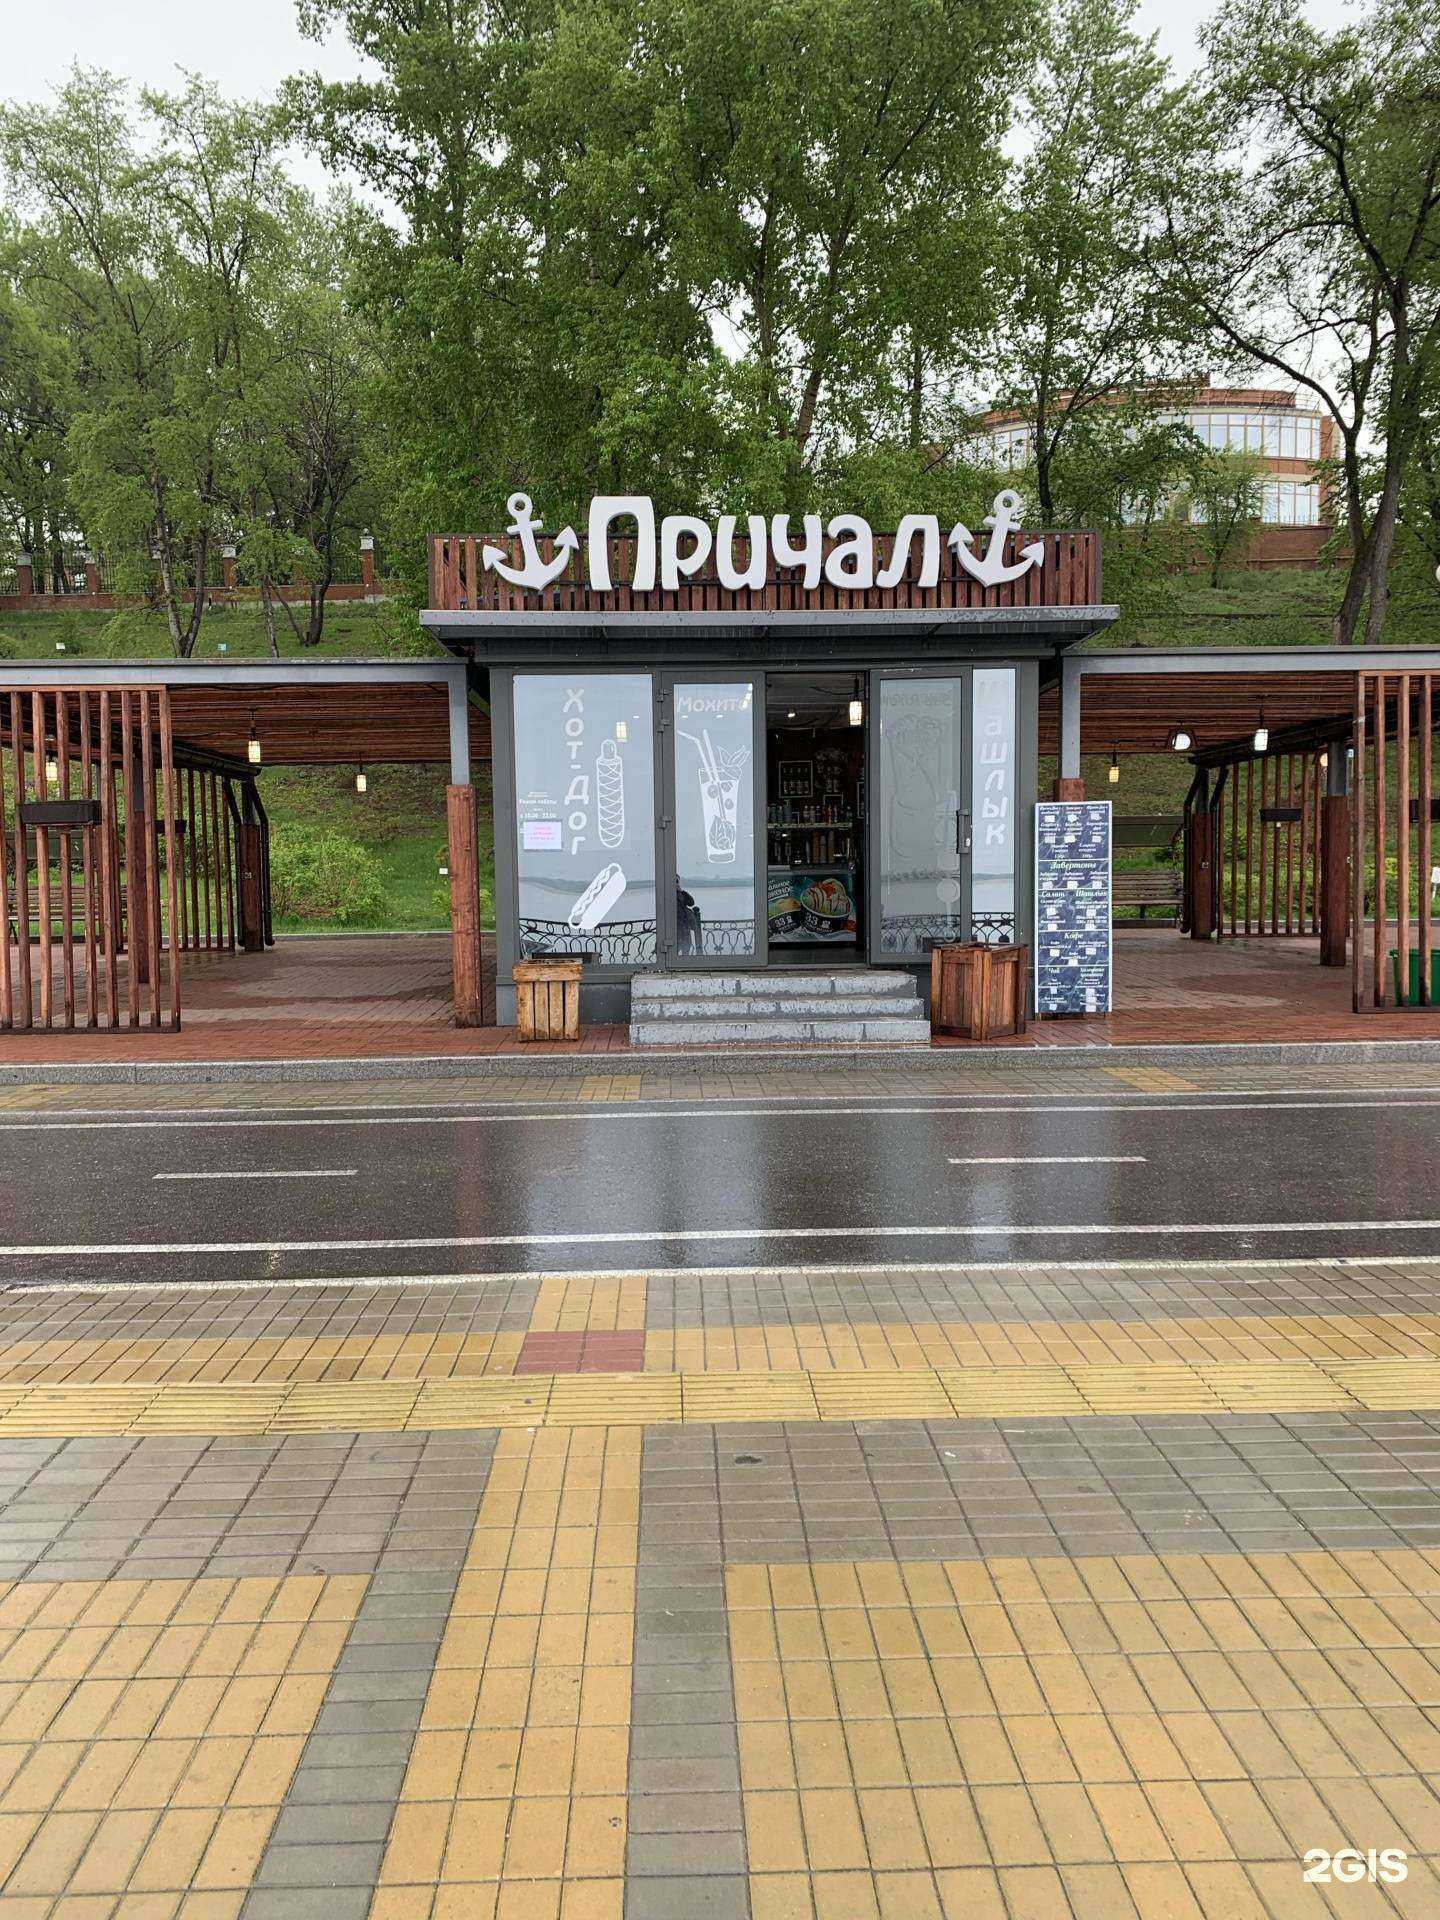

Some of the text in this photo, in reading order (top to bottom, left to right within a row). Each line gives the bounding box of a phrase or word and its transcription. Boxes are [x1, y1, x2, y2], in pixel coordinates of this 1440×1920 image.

[588, 495, 940, 591] Причал
[676, 696, 749, 713] Мохито
[977, 679, 1009, 846] ашлык
[1064, 932, 1084, 940] Кофе
